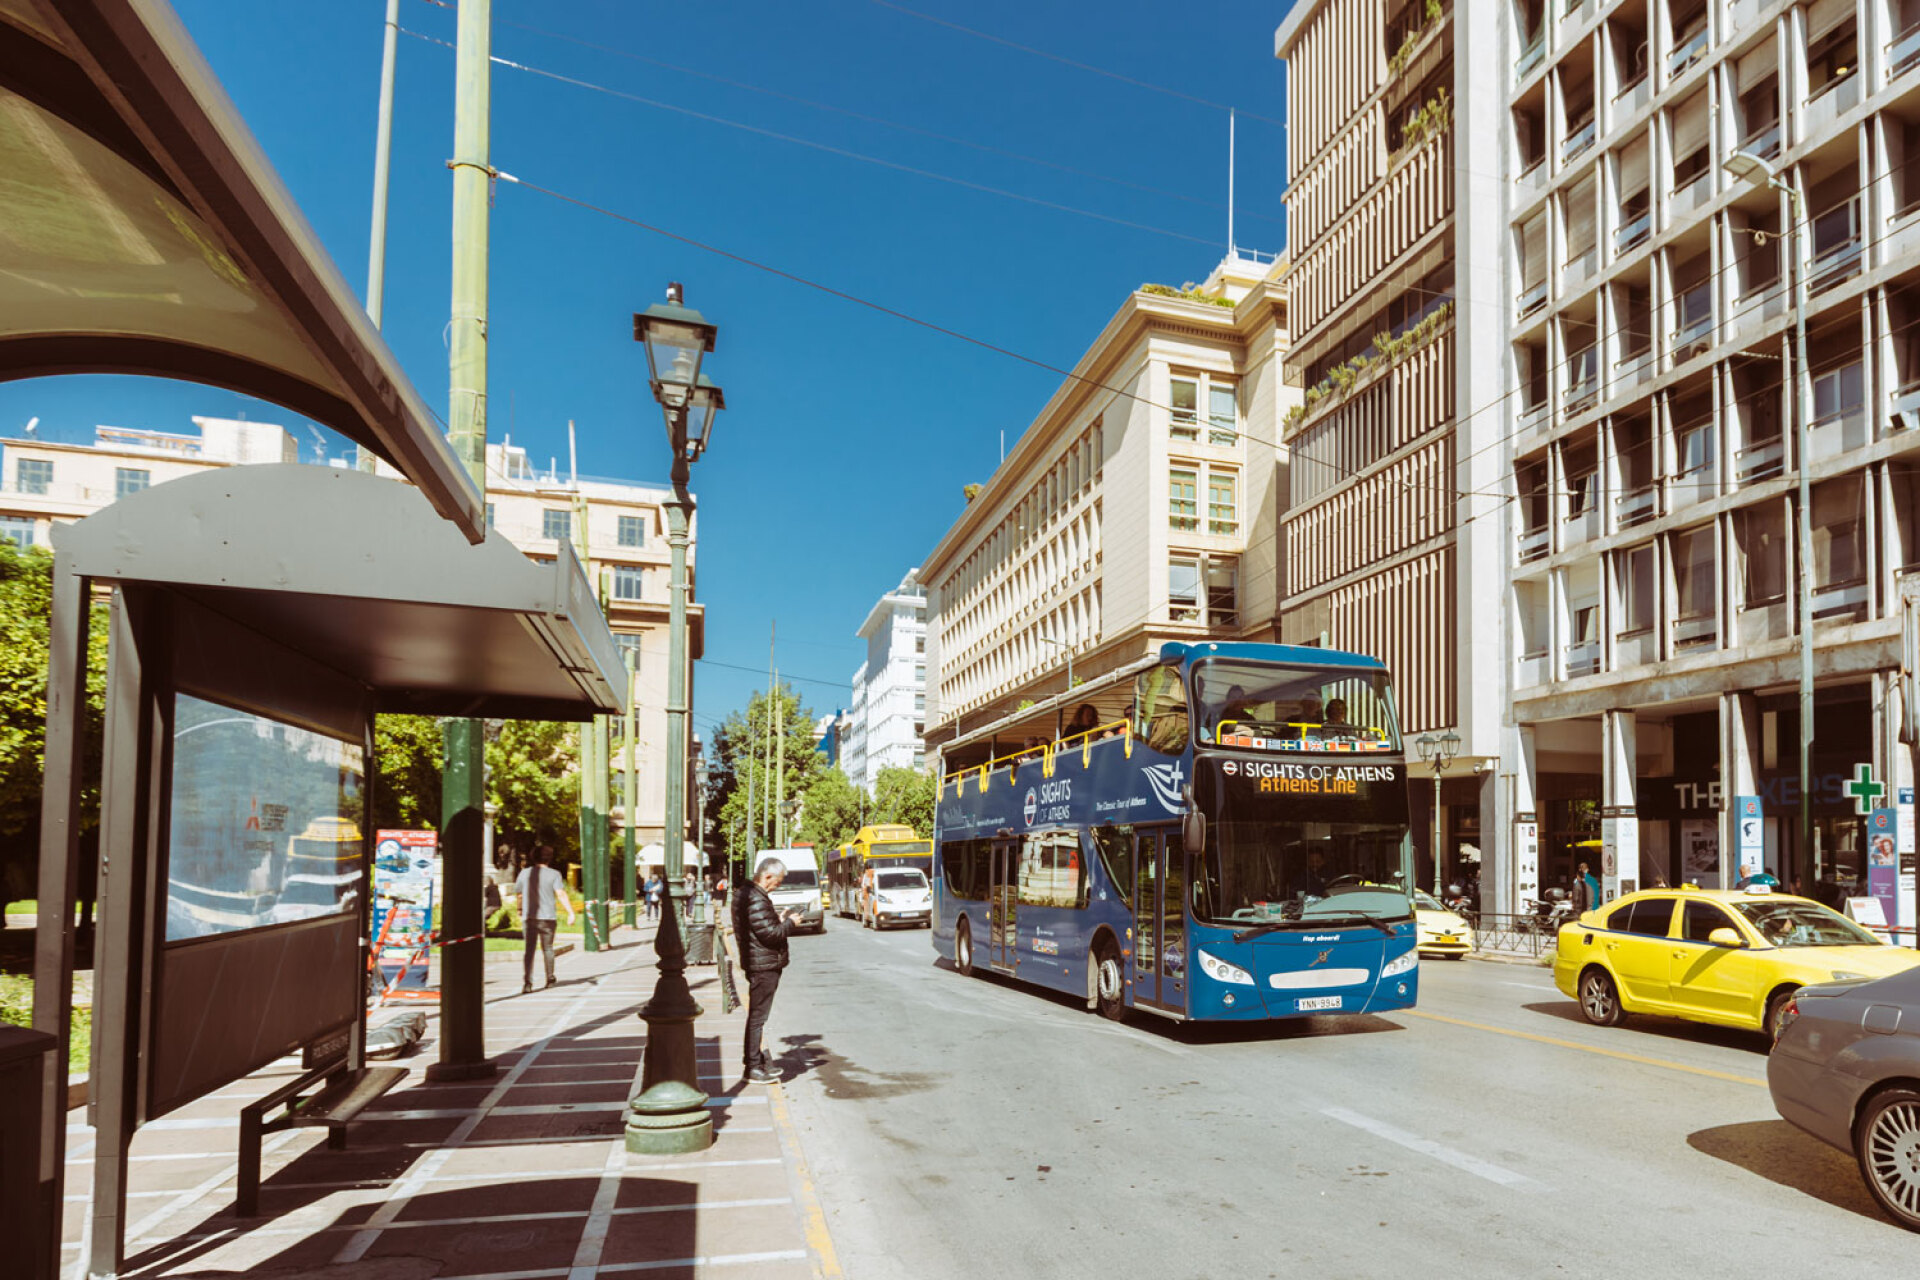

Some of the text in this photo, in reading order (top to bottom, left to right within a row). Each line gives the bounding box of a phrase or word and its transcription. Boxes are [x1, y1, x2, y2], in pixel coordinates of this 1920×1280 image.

[1246, 763, 1395, 781] SIGHTS OF ATHENS
[1041, 779, 1071, 804] SIGHTS
[1260, 777, 1357, 793] Athens Line
[1130, 797, 1147, 807] Athens
[1674, 781, 1721, 809] THE
[1040, 805, 1070, 822] OF ATHENS
